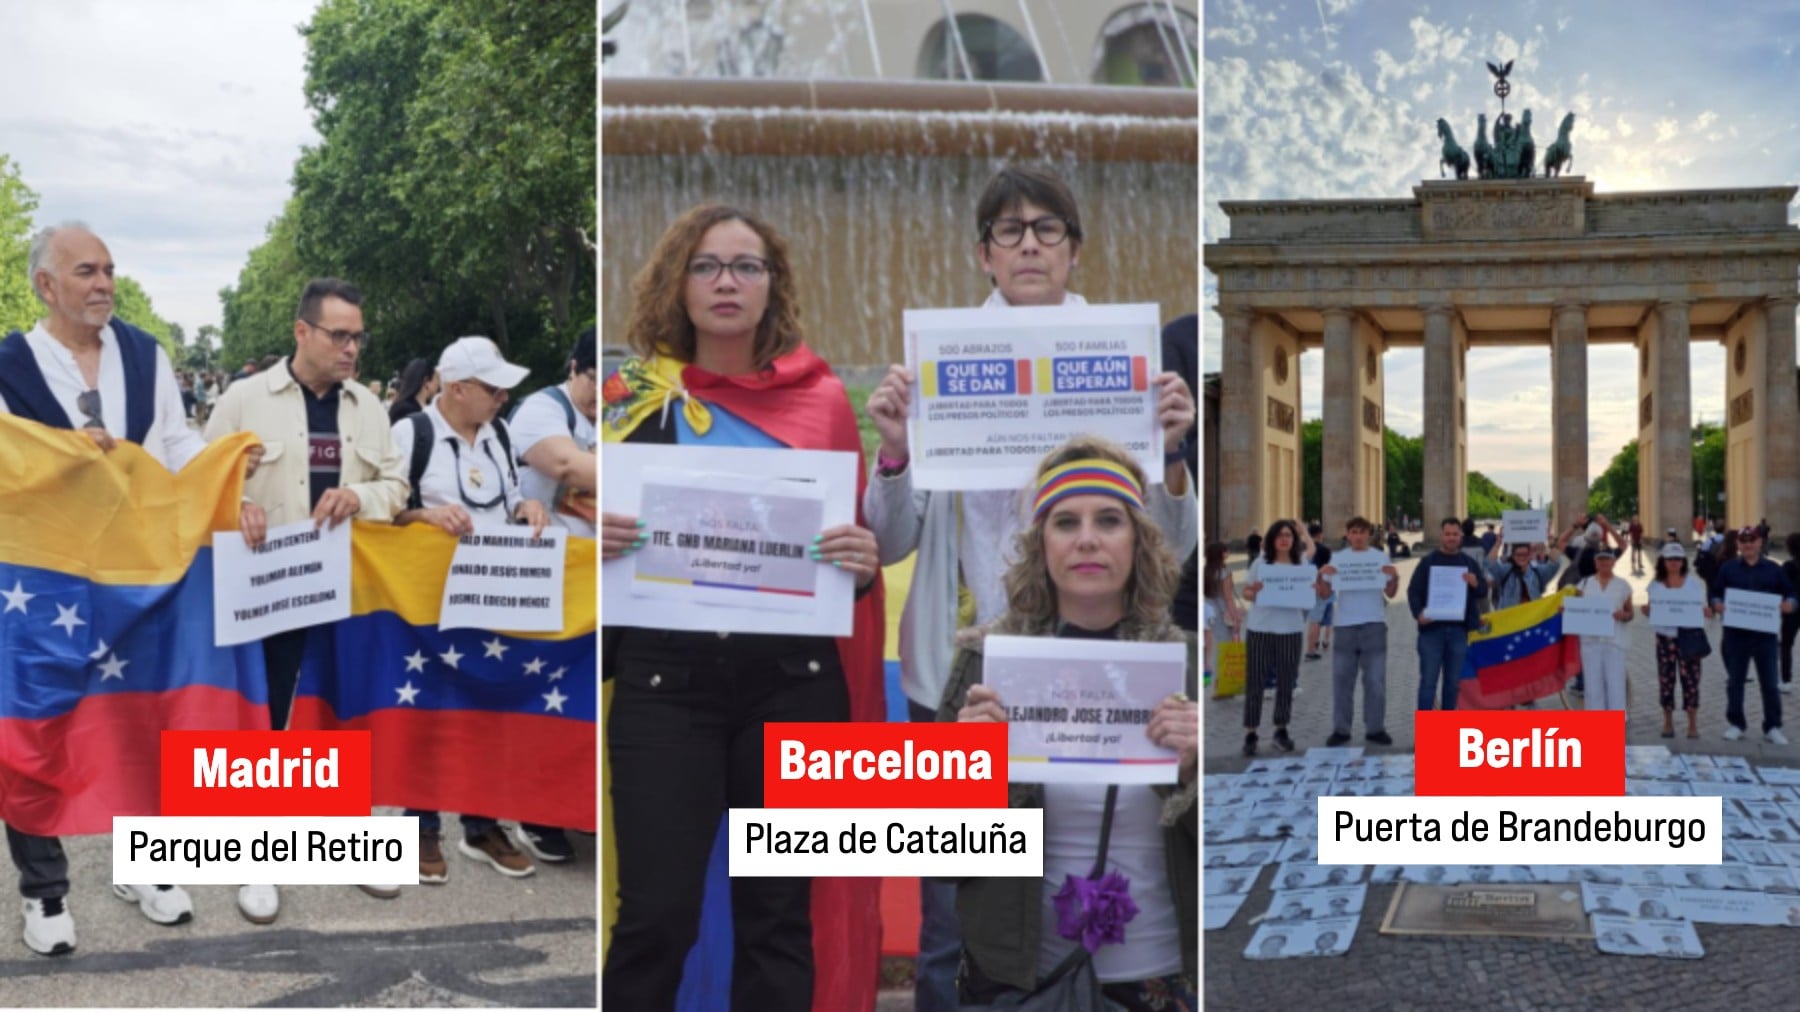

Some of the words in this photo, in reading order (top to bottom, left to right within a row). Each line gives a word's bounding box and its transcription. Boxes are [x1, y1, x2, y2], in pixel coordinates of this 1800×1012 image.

[962, 343, 1013, 354] ABRAZOS
[1079, 340, 1128, 351] FAMILIAS
[946, 363, 978, 379] QUE
[982, 362, 1007, 377] NO
[1056, 361, 1089, 376] QUE
[1093, 356, 1128, 374] AÚN
[948, 379, 967, 393] SE
[970, 378, 1006, 392] DAN
[1057, 375, 1128, 390] ESPERAN
[703, 535, 756, 554] MARIANA
[1105, 708, 1152, 725] ZAMBR
